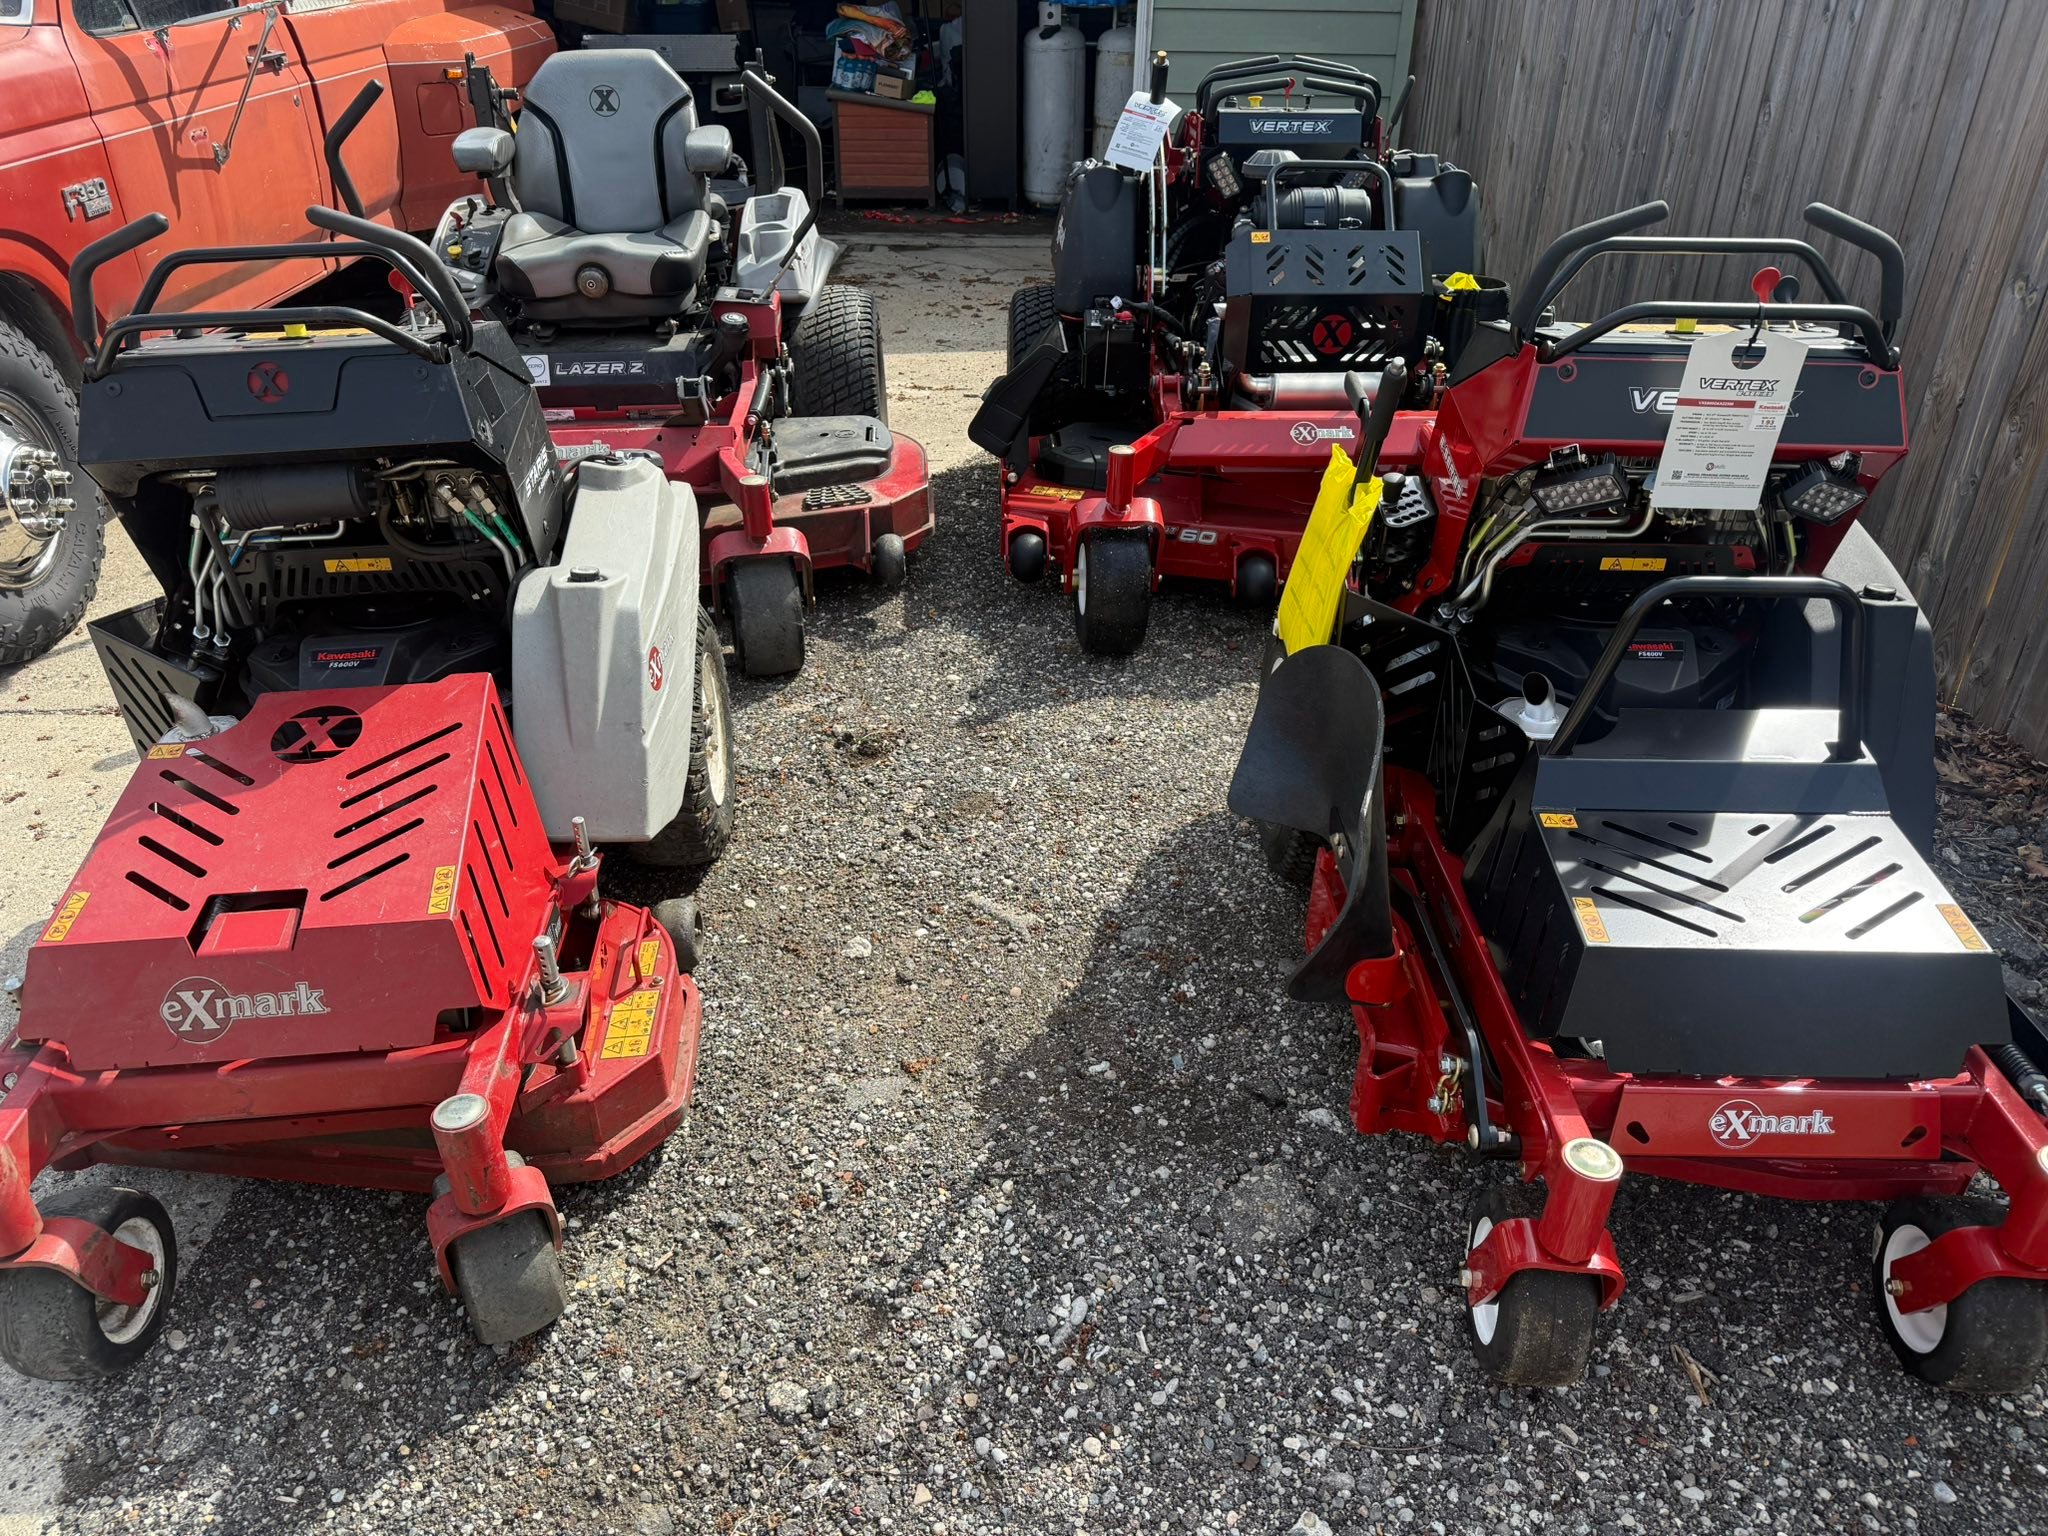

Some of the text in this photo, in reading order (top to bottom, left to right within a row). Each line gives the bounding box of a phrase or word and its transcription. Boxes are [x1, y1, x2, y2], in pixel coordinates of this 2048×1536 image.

[1249, 119, 1333, 134] VERTEX
[61, 177, 109, 222] F350
[555, 360, 646, 375] LAZER Z
[1700, 377, 1781, 392] VERTEX
[1290, 423, 1355, 443] eXmark
[1180, 529, 1217, 545] 60
[317, 649, 377, 661] Kawasaki
[161, 977, 331, 1032] eXmark
[1710, 1109, 1836, 1140] eXmark
